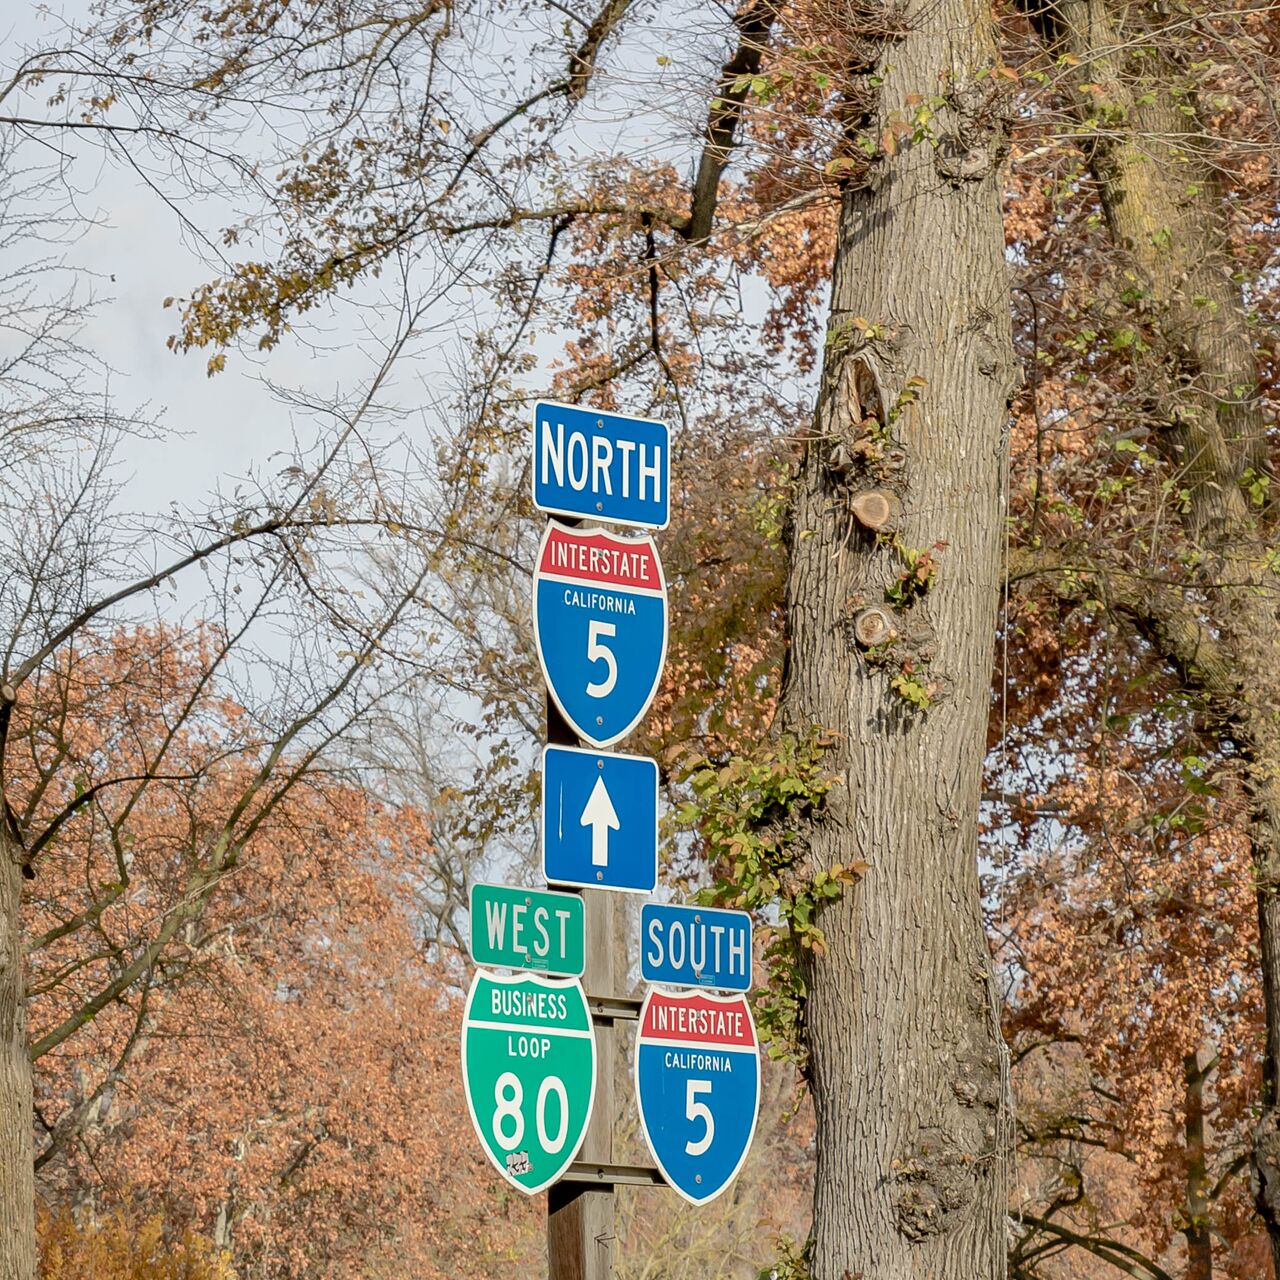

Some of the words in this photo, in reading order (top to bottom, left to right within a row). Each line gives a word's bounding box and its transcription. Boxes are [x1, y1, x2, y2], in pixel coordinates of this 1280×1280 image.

[541, 420, 661, 503] NORTH
[550, 540, 650, 581] INTERSTATE
[564, 589, 636, 615] CALIFORNIA
[585, 620, 618, 698] 5
[485, 900, 571, 959] WEST
[647, 918, 746, 976] SOUTH
[491, 989, 568, 1020] BUSINESS
[651, 1005, 744, 1037] INTERSTATE
[508, 1036, 551, 1059] LOOP
[665, 1052, 732, 1073] CALIFORNIA
[492, 1071, 569, 1154] 80
[685, 1079, 715, 1156] 5
